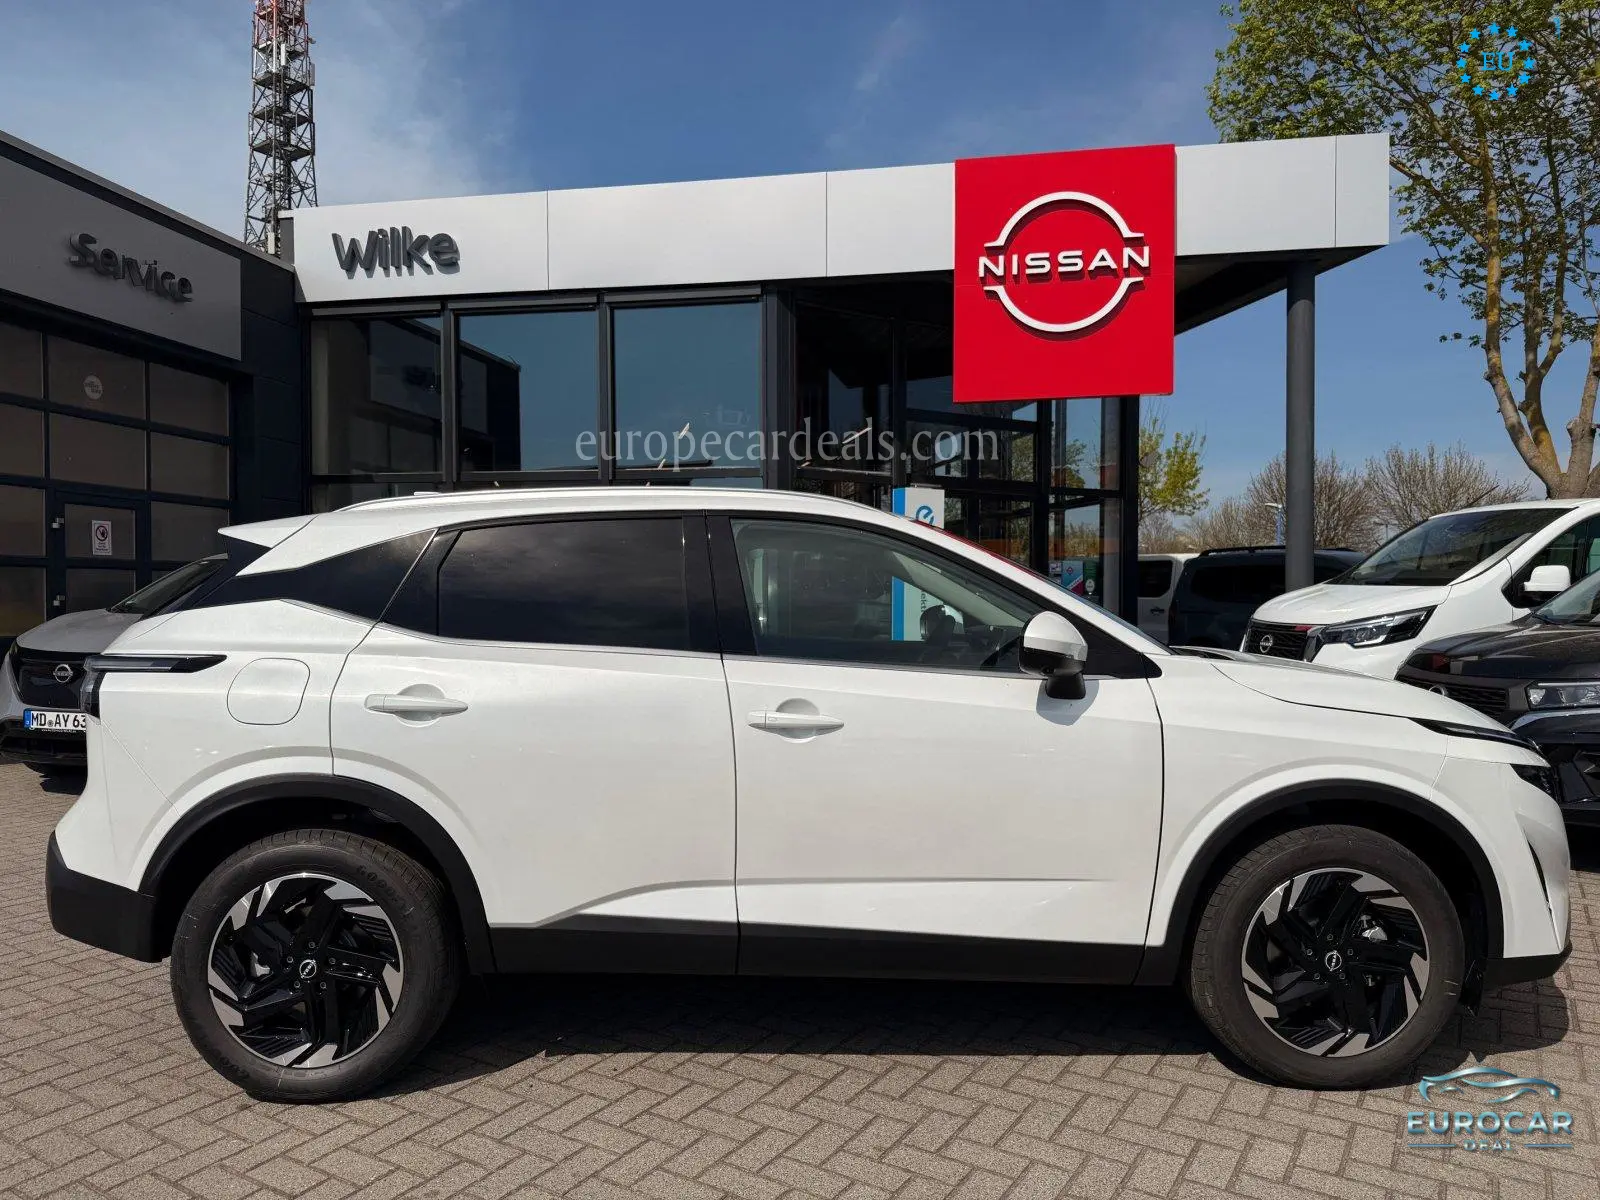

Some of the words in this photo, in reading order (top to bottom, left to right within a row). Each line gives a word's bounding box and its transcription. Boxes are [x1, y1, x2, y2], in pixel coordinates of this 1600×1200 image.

[69, 232, 194, 303] Service
[331, 225, 461, 275] Wilke
[978, 245, 1150, 278] NISSAN
[31, 712, 47, 727] MD
[54, 713, 70, 728] AY
